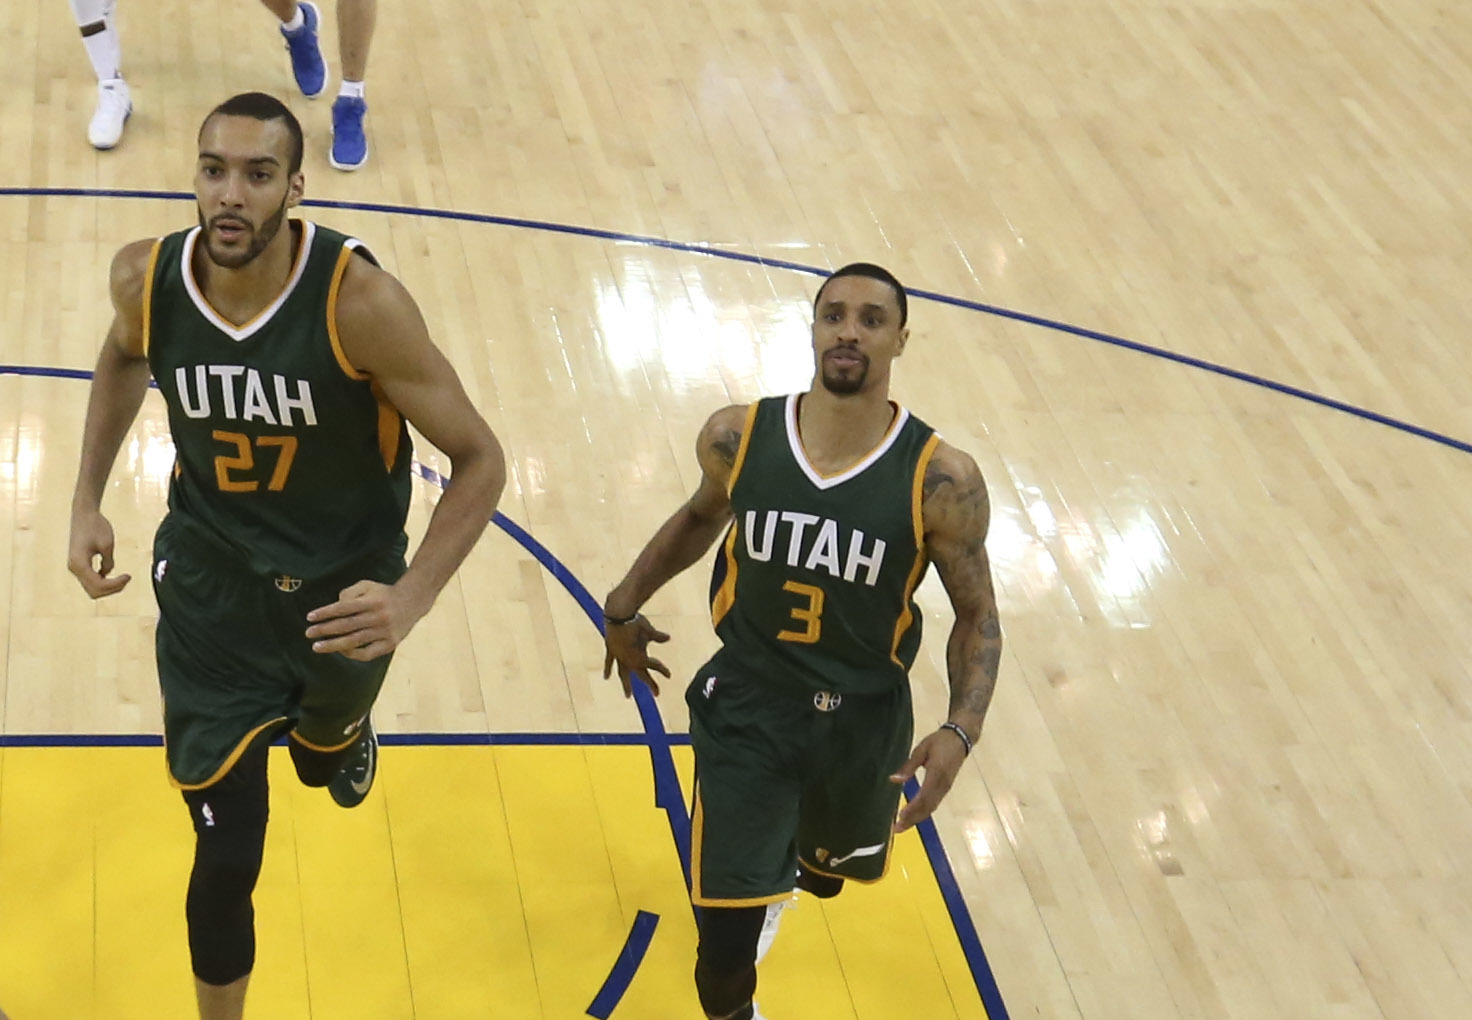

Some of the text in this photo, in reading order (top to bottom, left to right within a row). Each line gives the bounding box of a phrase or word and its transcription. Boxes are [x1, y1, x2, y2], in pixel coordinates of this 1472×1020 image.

[176, 365, 318, 426] UTAH
[212, 430, 298, 491] 27
[745, 510, 887, 586] UTAH
[777, 580, 824, 644] 3
